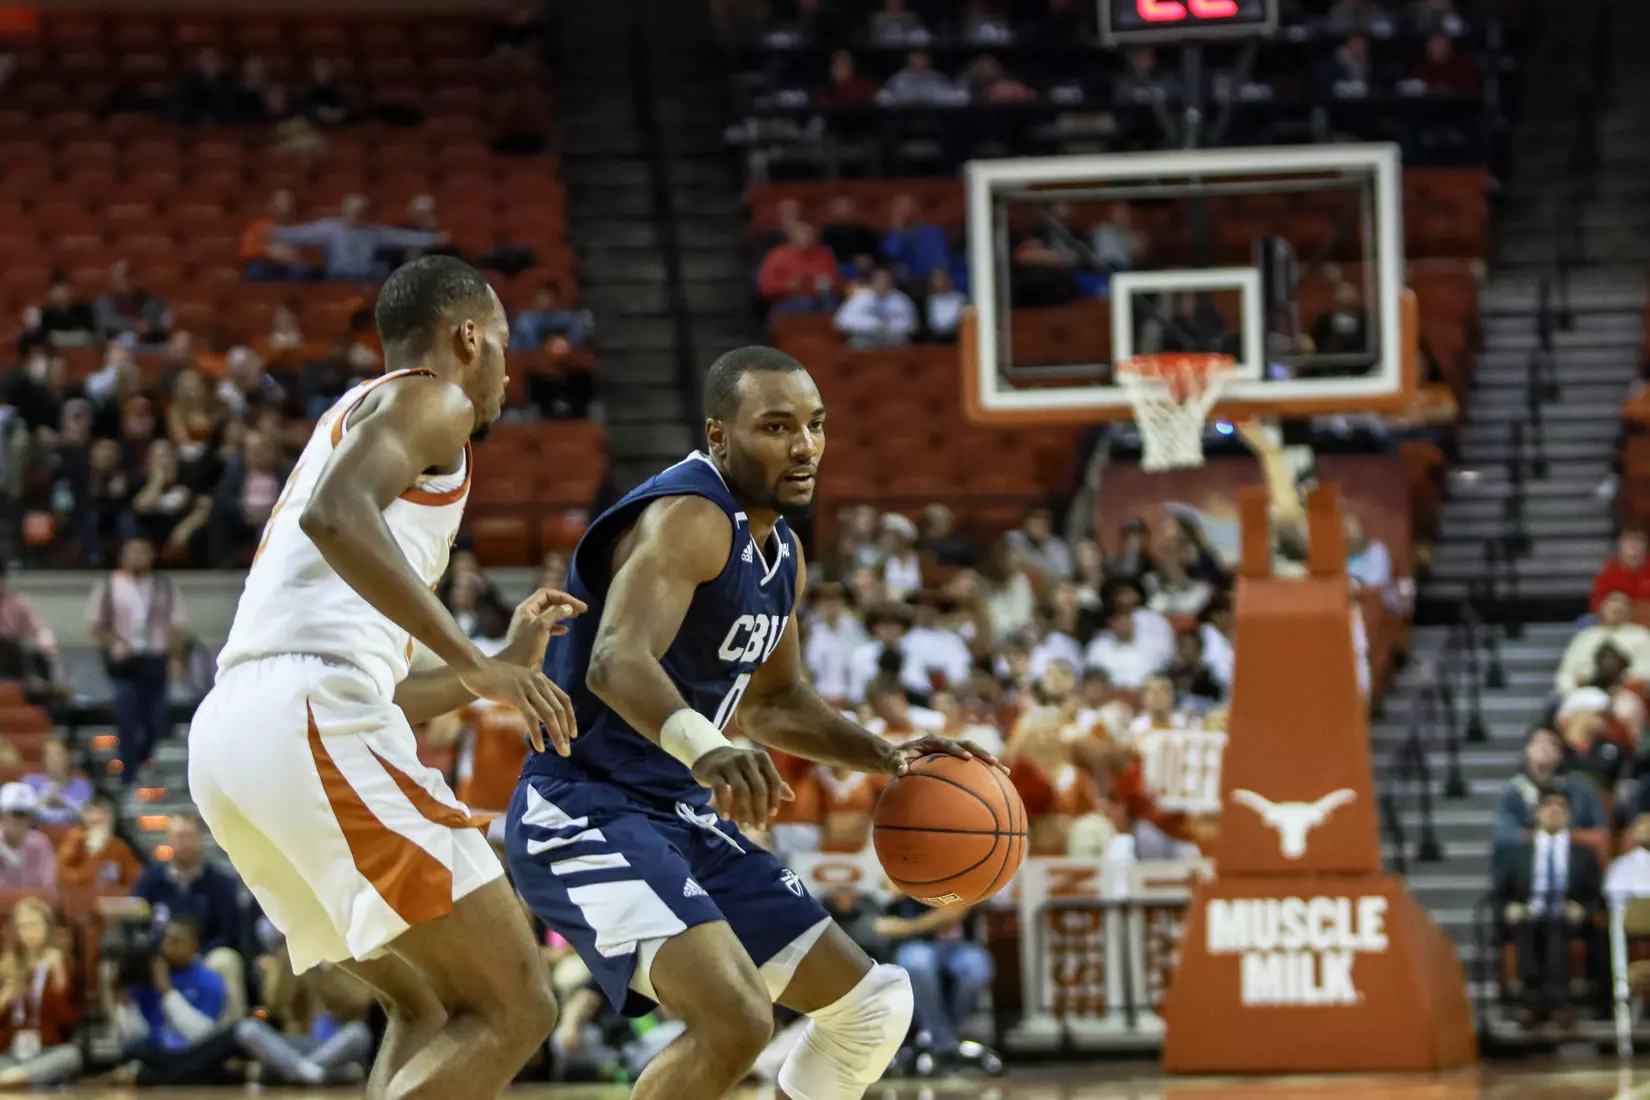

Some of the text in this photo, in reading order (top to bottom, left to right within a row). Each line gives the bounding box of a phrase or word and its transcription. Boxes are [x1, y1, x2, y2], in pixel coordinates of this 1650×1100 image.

[718, 614, 788, 663] CBU
[1207, 897, 1388, 952] MUSCLE
[1242, 951, 1358, 1005] MILK
